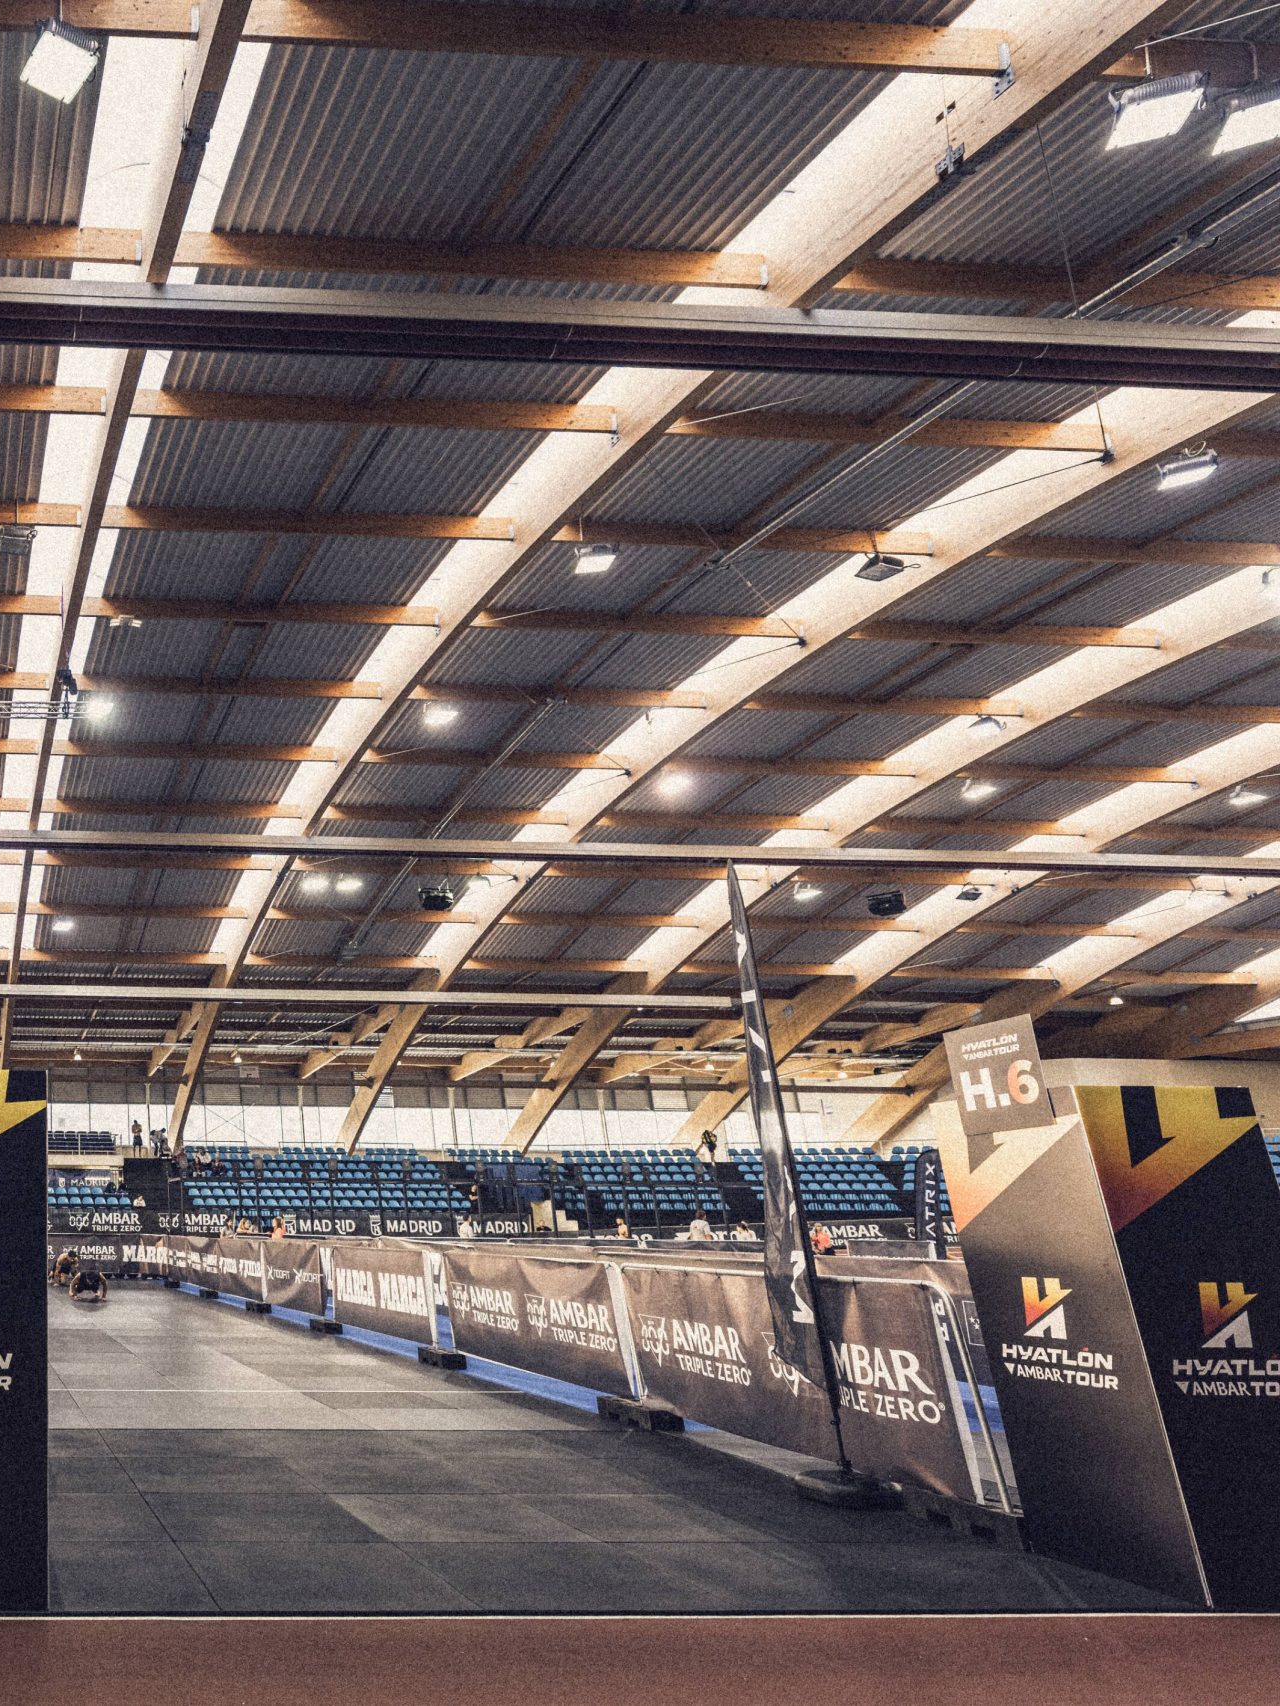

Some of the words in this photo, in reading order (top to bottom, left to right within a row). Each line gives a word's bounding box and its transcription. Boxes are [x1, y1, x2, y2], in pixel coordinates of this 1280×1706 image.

[992, 1044, 1019, 1056] TOUR
[960, 1059, 1039, 1111] H.6
[925, 1162, 936, 1244] ATRIX
[92, 1213, 140, 1224] AMBAR
[299, 1219, 356, 1235] MADRID
[386, 1219, 443, 1235] MADRID
[80, 1245, 116, 1255] AMBAR
[336, 1268, 376, 1307] MARCA
[378, 1272, 428, 1316] MARCA
[470, 1285, 517, 1316] AMBAR
[471, 1309, 496, 1327] TRIPLE
[549, 1299, 613, 1335] AMBAR
[551, 1326, 588, 1346] TRIPLE
[672, 1319, 747, 1365] AMBAR
[675, 1353, 714, 1379] TRIPLE
[829, 1340, 937, 1396] MBAR
[1017, 1364, 1064, 1384] AMBAR
[1063, 1370, 1118, 1390] TOUR
[1192, 1381, 1249, 1397] AMBAR
